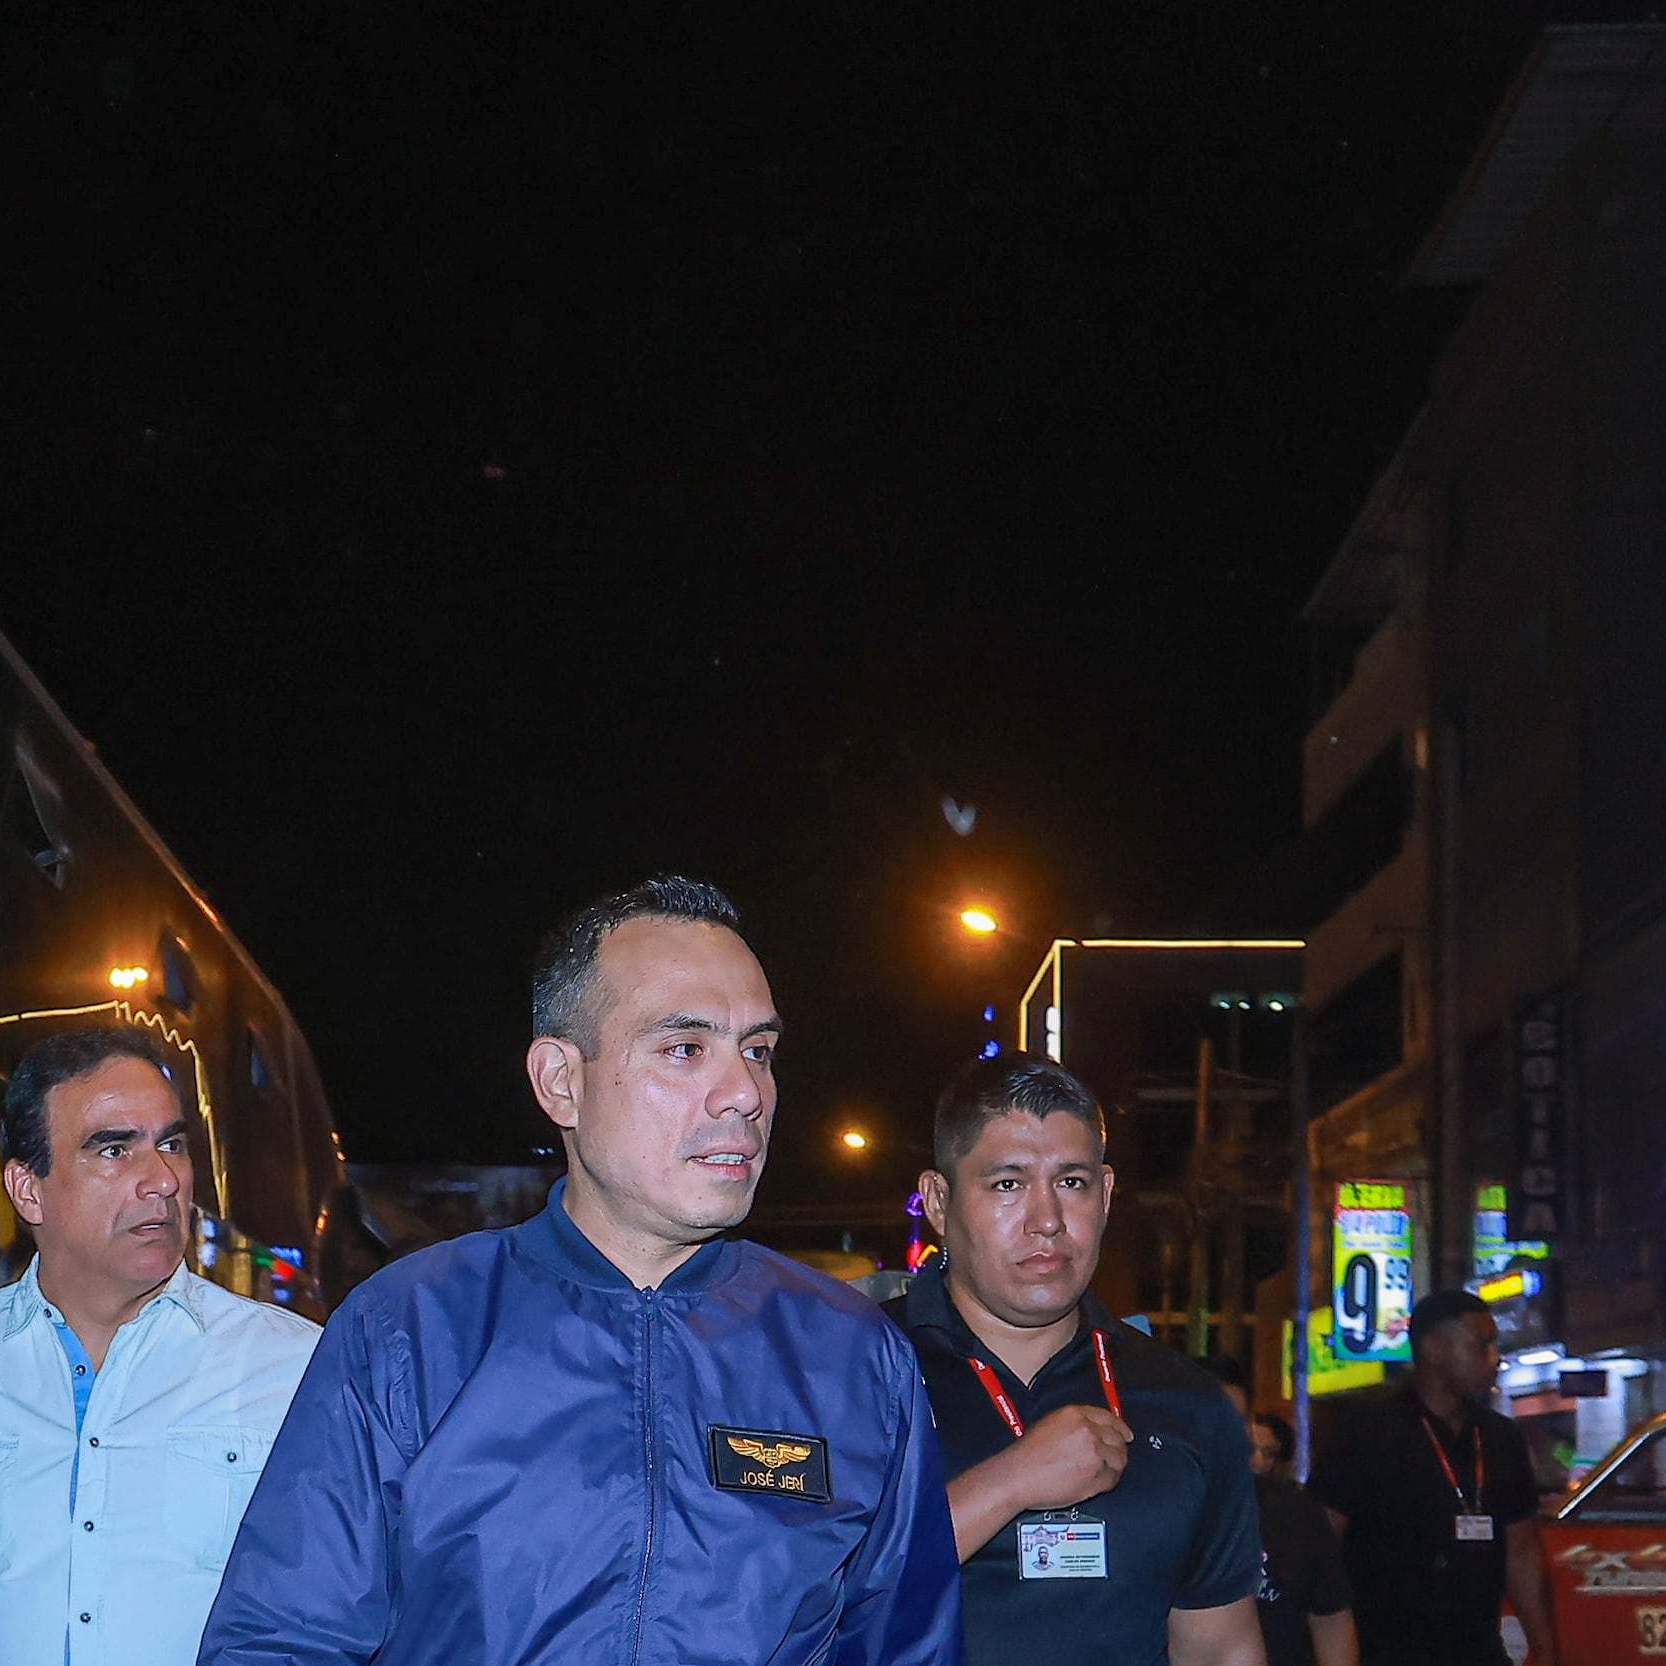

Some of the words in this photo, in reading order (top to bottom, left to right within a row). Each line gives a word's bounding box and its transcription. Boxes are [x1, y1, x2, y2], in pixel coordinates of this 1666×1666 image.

[1343, 1253, 1377, 1354] 9
[739, 1469, 775, 1487] JOSÉ
[778, 1472, 807, 1492] JERÍ
